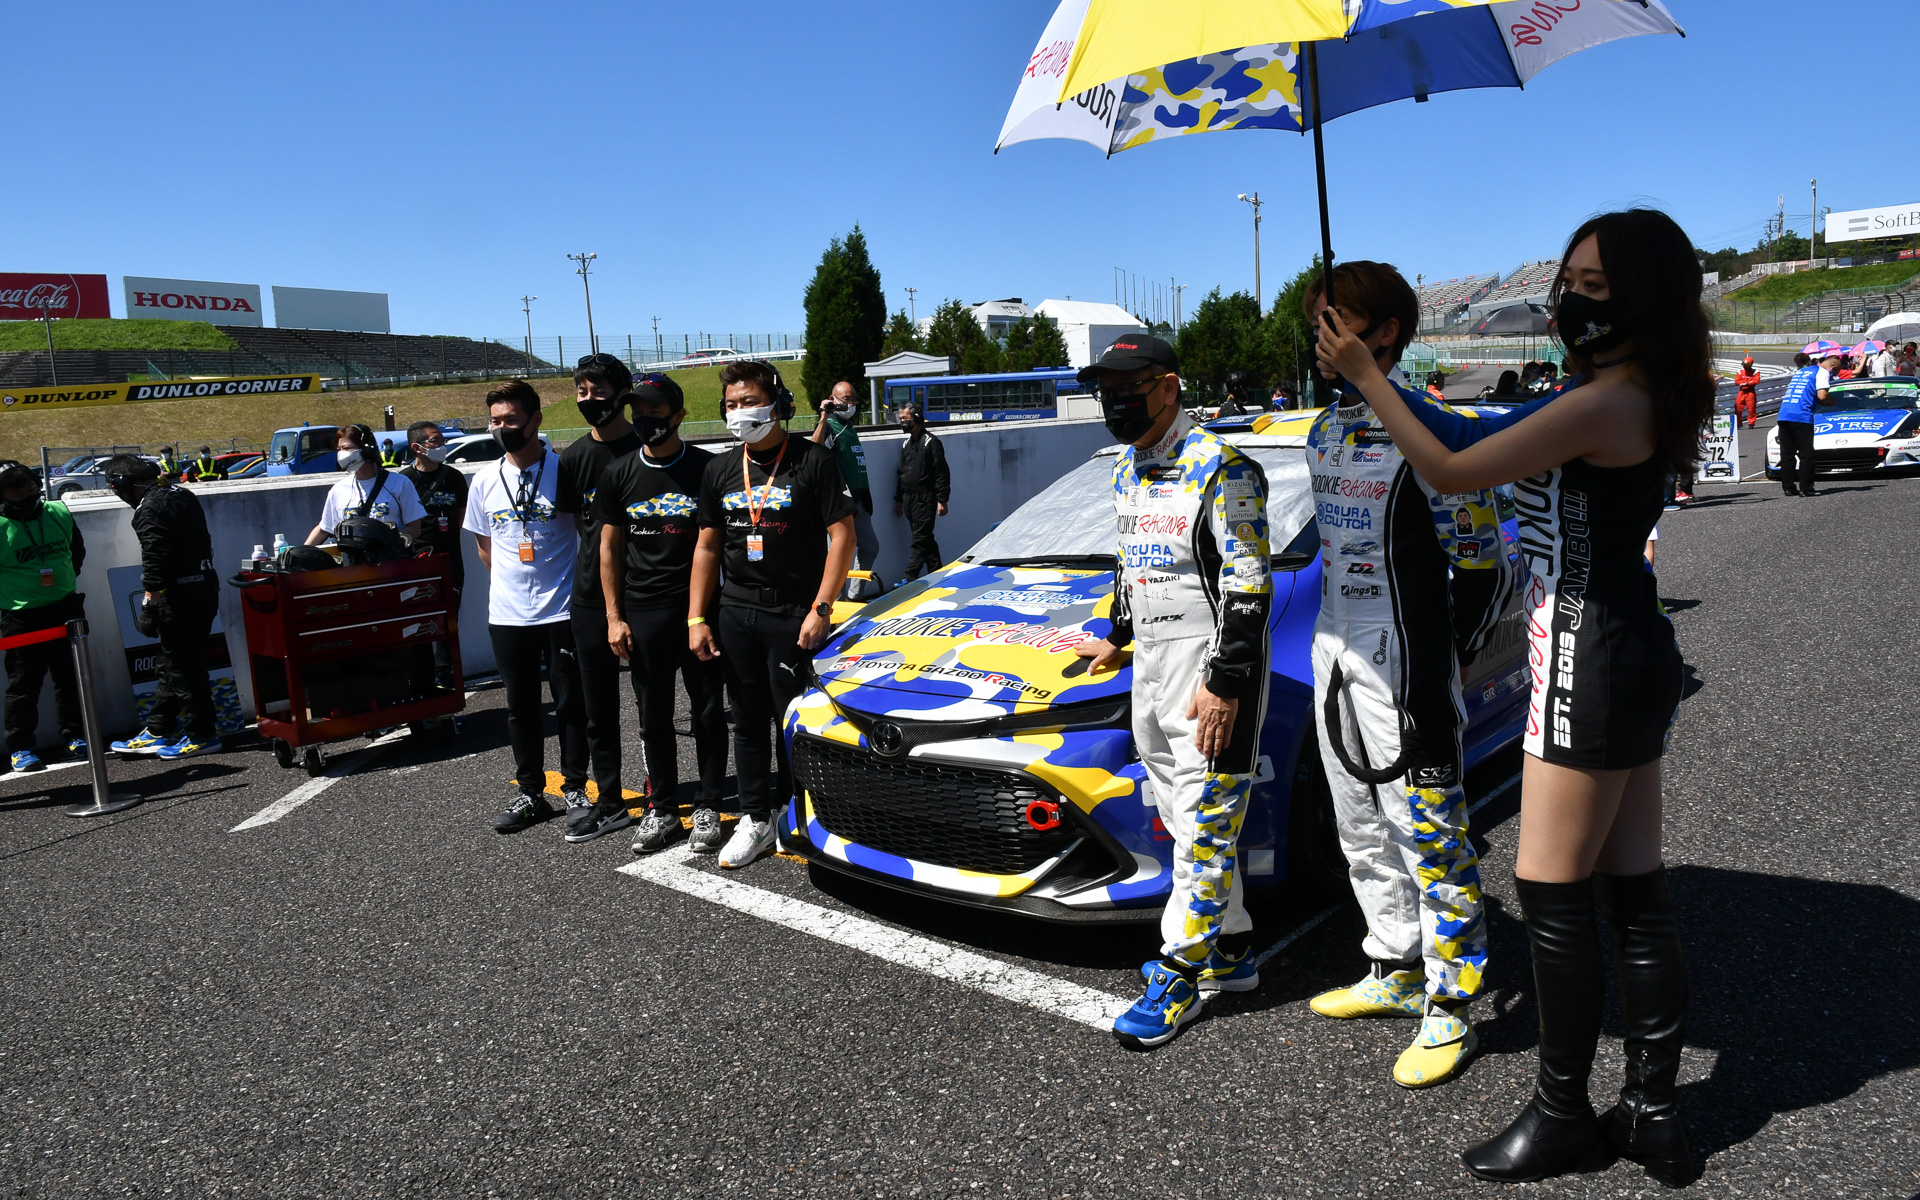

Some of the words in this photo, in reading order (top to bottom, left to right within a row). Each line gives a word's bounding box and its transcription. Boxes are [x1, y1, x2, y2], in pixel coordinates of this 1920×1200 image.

[0, 283, 73, 309] ca-Cola
[133, 292, 255, 312] HONDA
[22, 390, 117, 404] DUNLOP
[137, 383, 222, 399] DUNLOP
[225, 378, 303, 394] CORNER
[1705, 435, 1734, 443] NATS
[1709, 447, 1725, 461] 72
[1340, 479, 1389, 500] RACING
[1325, 502, 1371, 518] OGURA
[1138, 513, 1188, 536] RACING
[1325, 514, 1372, 530] CLUTCH
[1127, 544, 1174, 556] OGURA
[1347, 562, 1375, 574] D2
[1148, 574, 1181, 583] YAZAKI
[864, 617, 976, 638] ROOKIE
[958, 621, 1093, 653] RACING
[1557, 632, 1576, 691] 2019
[858, 660, 917, 672] TOYOTA
[918, 663, 983, 680] GAZOO
[983, 674, 1052, 699] Racing
[1483, 688, 1496, 701] GR
[1553, 697, 1572, 749] EST.
